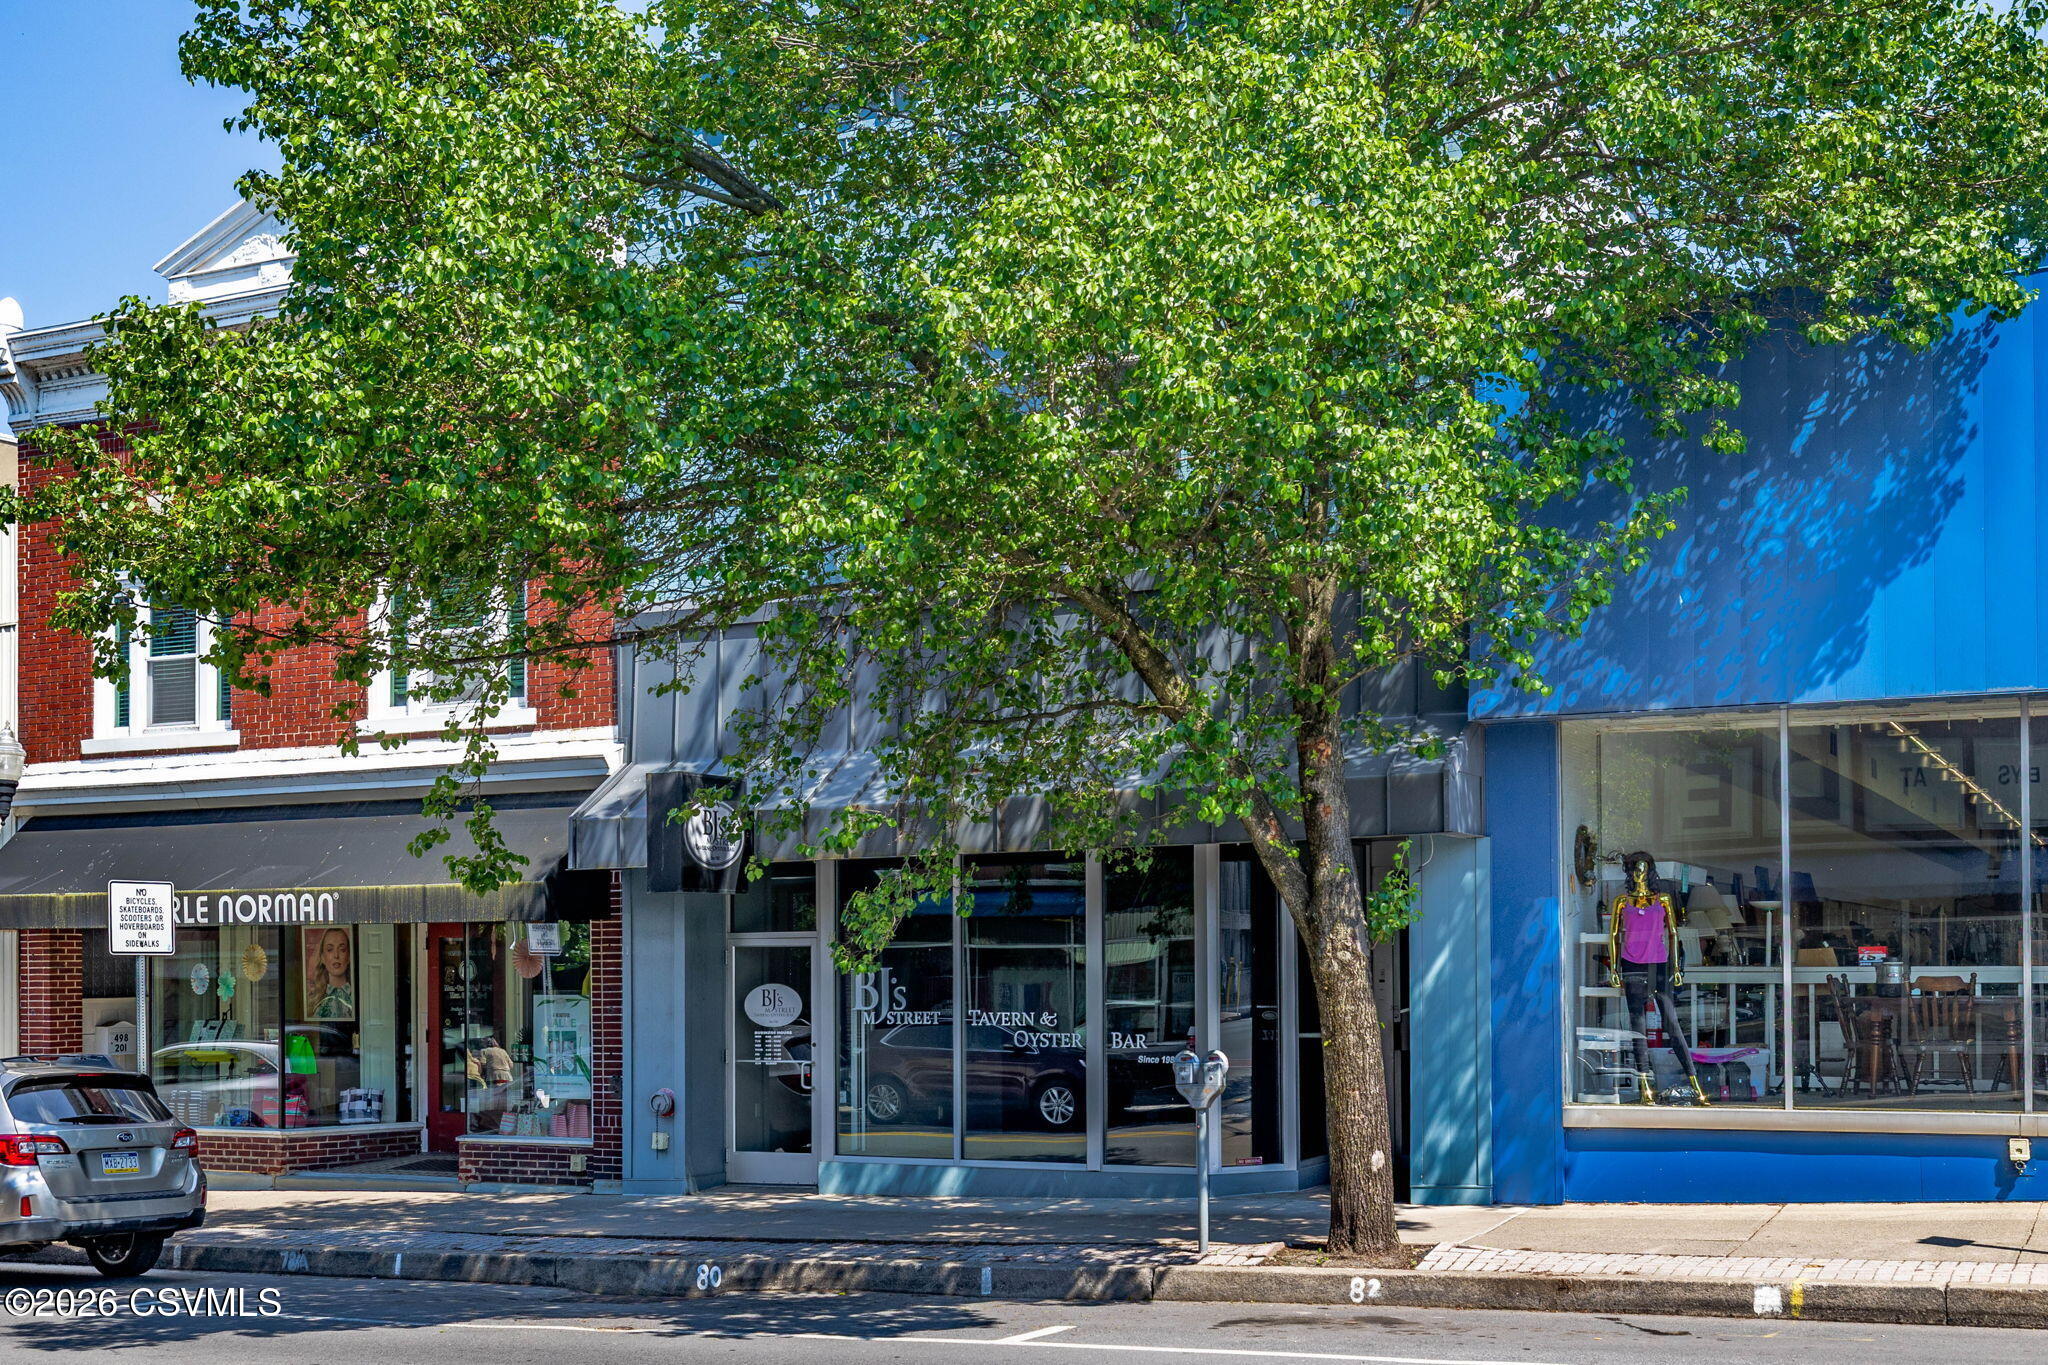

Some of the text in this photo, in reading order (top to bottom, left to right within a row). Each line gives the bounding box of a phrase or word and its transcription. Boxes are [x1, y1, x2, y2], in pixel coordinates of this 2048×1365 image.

[136, 888, 147, 897] NO
[120, 914, 164, 922] SCOOTERS OR
[119, 922, 165, 930] HOVERBOARDS
[137, 931, 147, 939] ON
[125, 939, 160, 948] SIDEWALKS
[761, 988, 784, 1011] BJ's
[852, 967, 907, 1024] BJ's
[863, 1009, 1058, 1027] M STREET TAVERN &
[114, 1033, 129, 1042] 498
[1013, 1030, 1148, 1049] OYSTER BAR
[115, 1043, 127, 1052] 201
[1137, 1054, 1176, 1064] Since 198
[696, 1263, 722, 1290] 80
[1349, 1276, 1382, 1304] 82
